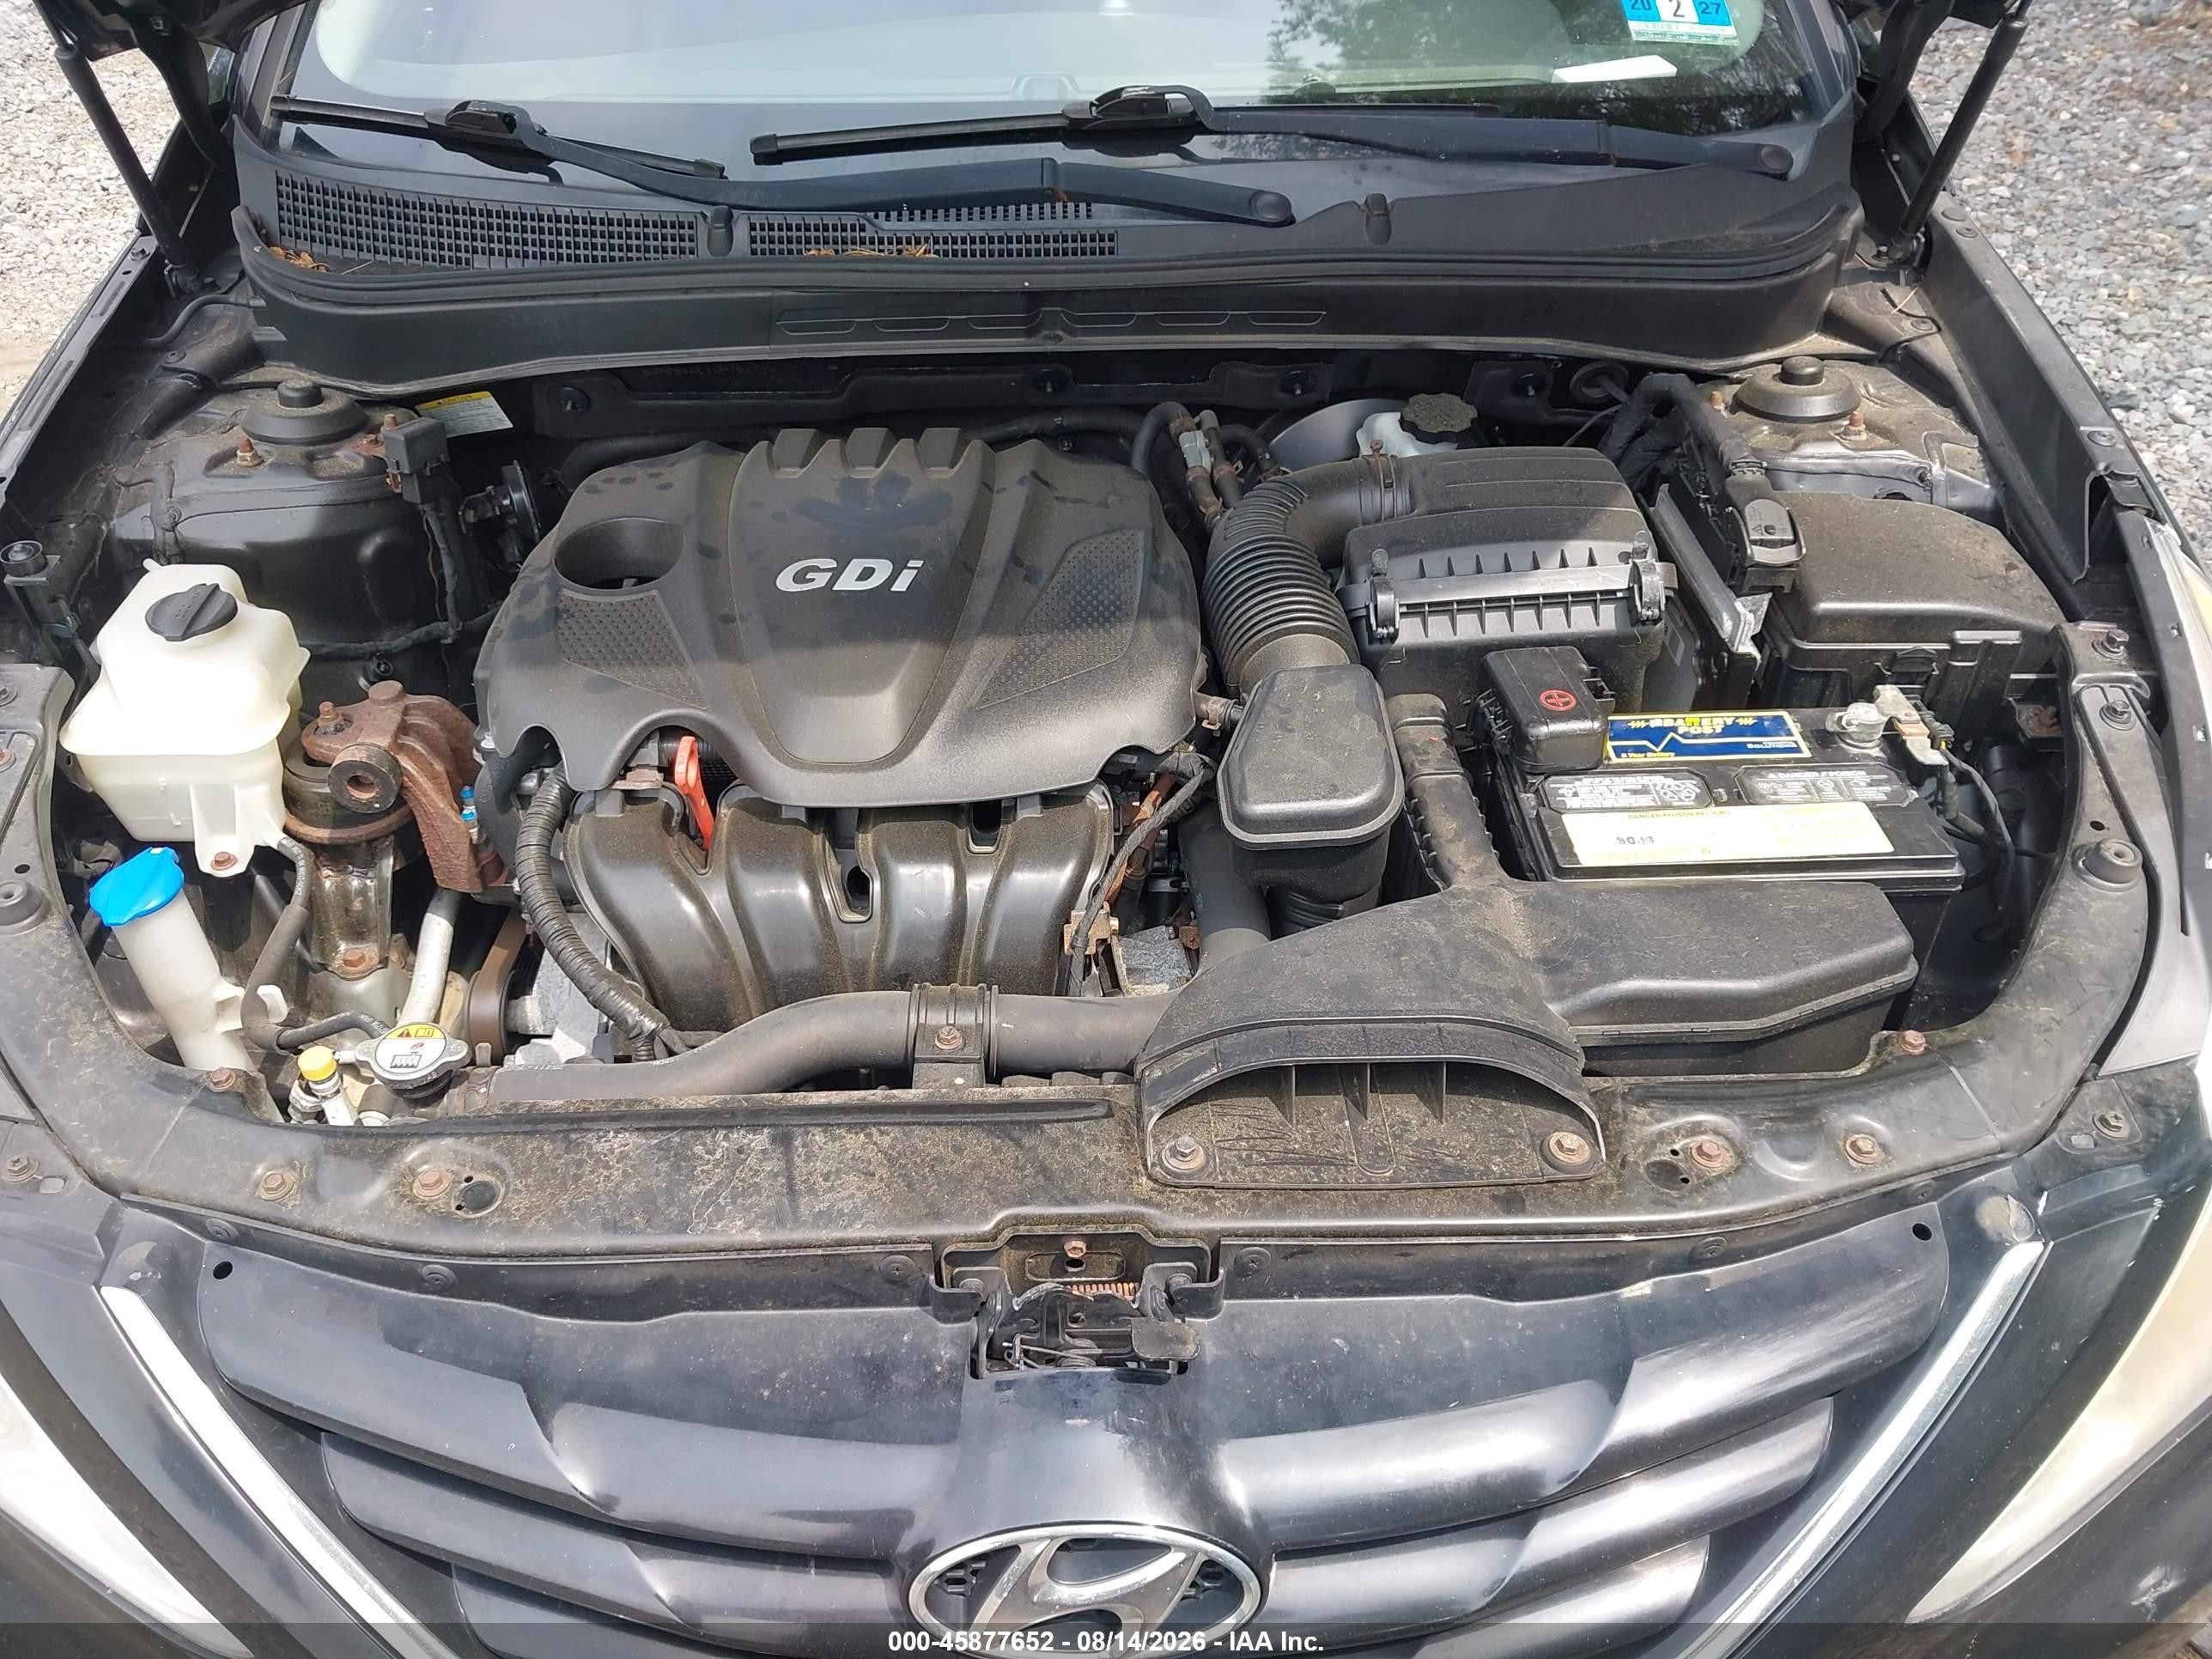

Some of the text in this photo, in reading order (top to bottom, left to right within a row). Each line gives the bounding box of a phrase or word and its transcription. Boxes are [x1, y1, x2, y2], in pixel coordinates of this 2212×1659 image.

[1632, 0, 1721, 17] 20 2 27
[775, 558, 925, 592] GDi
[1678, 725, 1724, 734] POST
